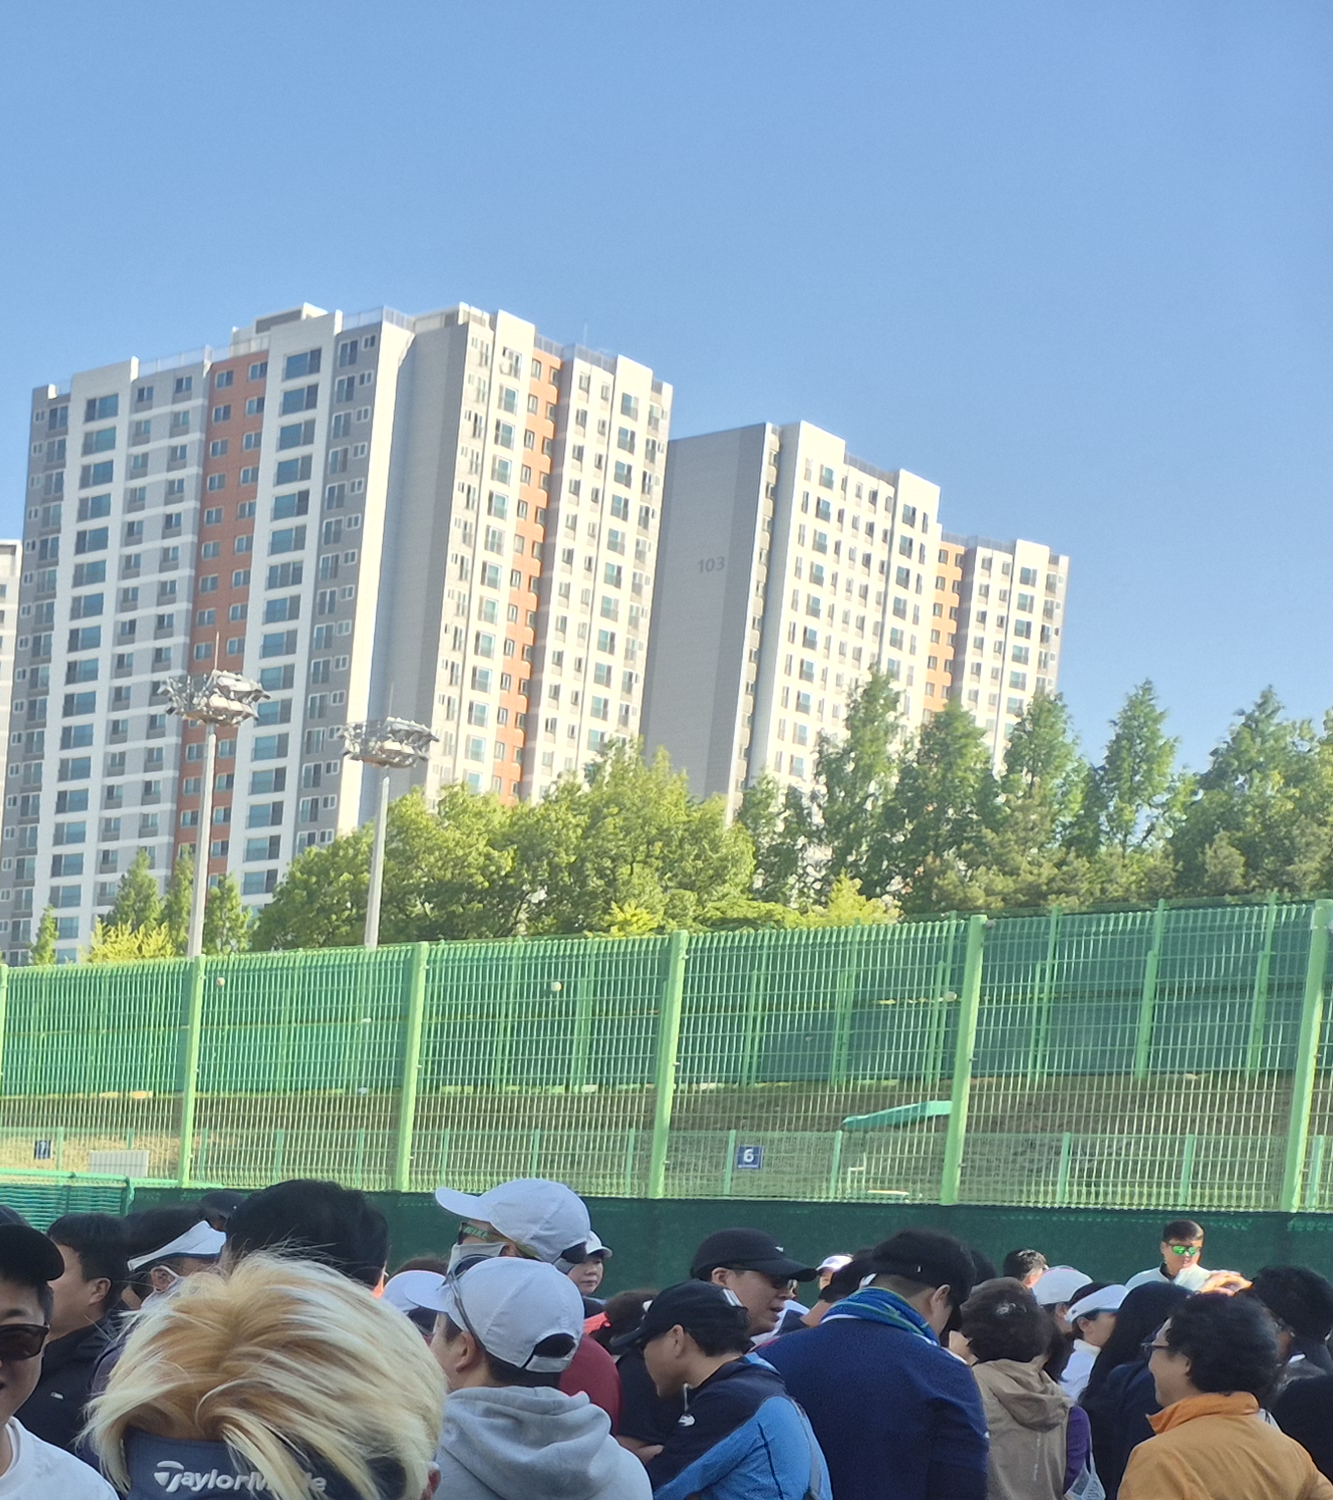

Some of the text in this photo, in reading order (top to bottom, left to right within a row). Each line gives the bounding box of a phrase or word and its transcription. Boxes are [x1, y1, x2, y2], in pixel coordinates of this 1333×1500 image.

[697, 556, 725, 574] 103
[744, 1149, 754, 1163] 6
[154, 1460, 327, 1493] TaylorMe
